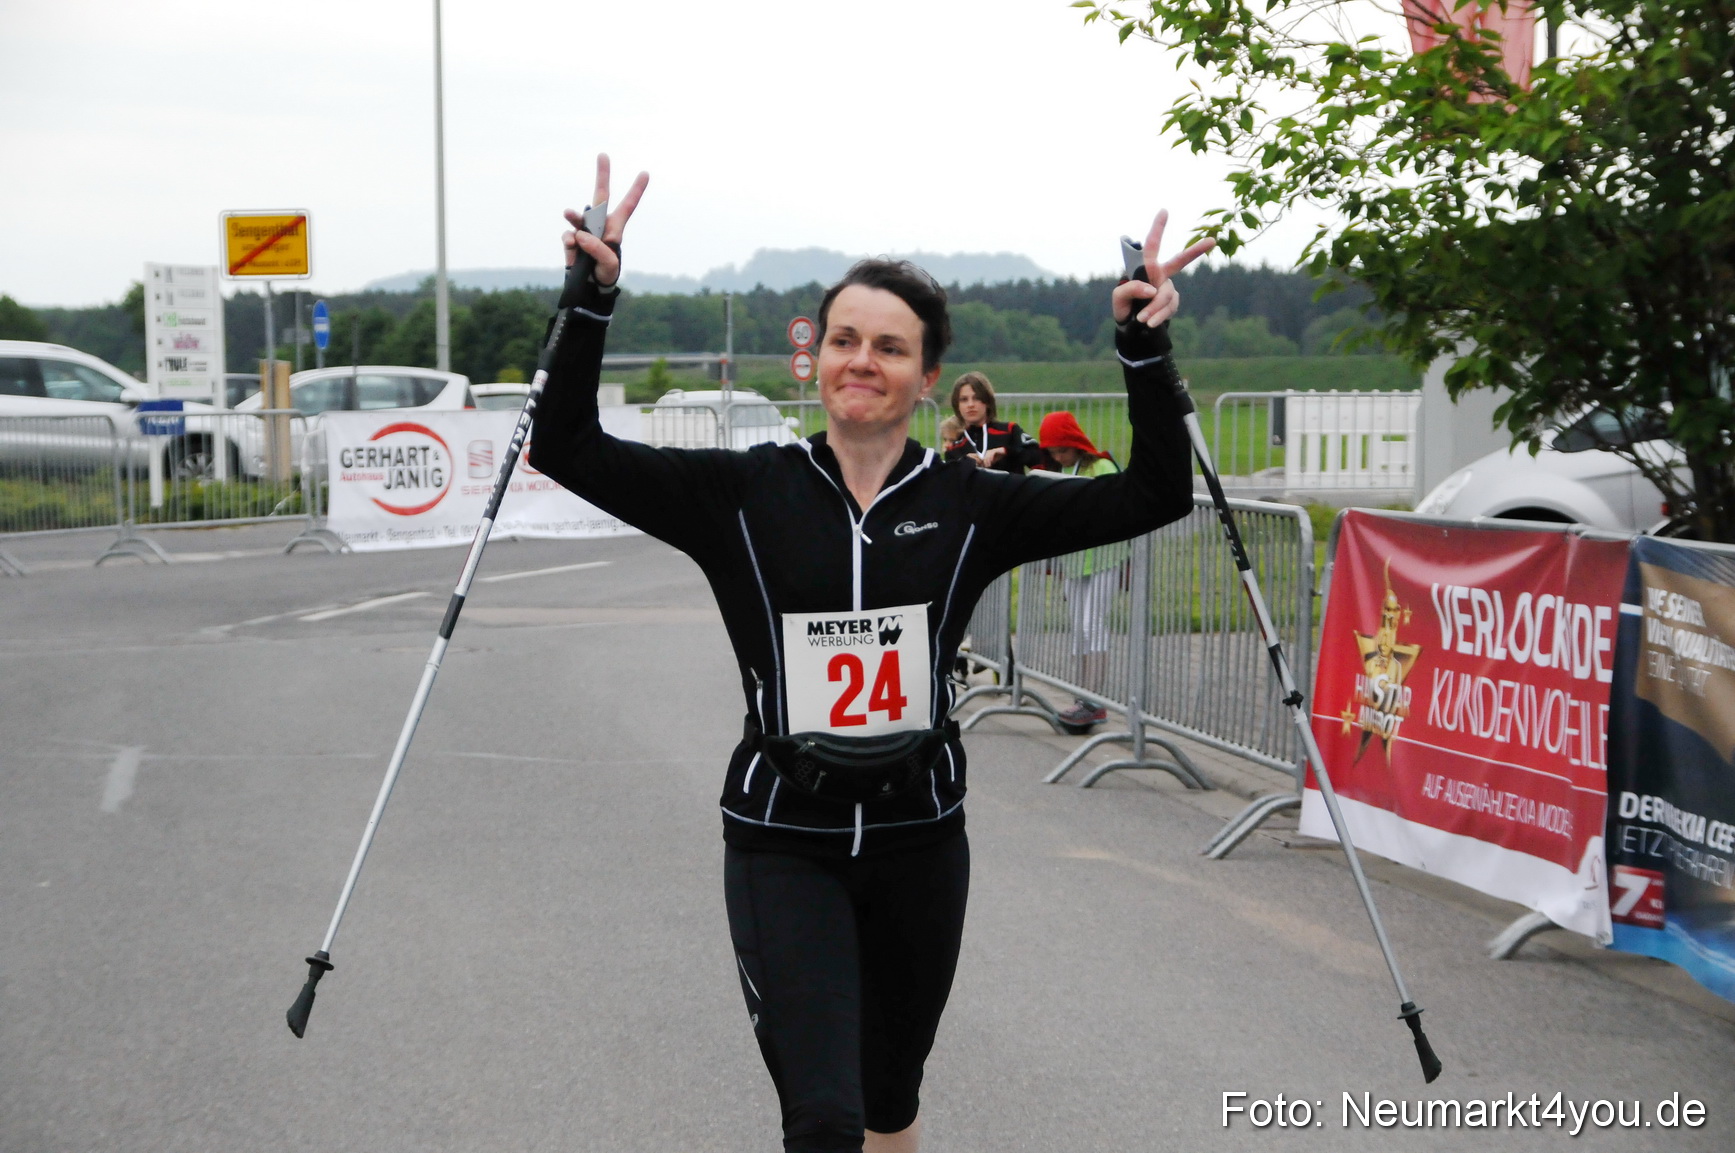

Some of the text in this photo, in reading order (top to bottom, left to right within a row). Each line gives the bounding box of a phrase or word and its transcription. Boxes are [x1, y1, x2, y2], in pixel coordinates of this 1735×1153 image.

[340, 446, 430, 468] GERHART
[461, 485, 492, 495] SEA
[807, 619, 873, 636] MEYER
[807, 633, 874, 647] WERBUNG
[827, 649, 908, 728] 24
[1422, 772, 1445, 799] AUF
[1611, 871, 1651, 917] 7
